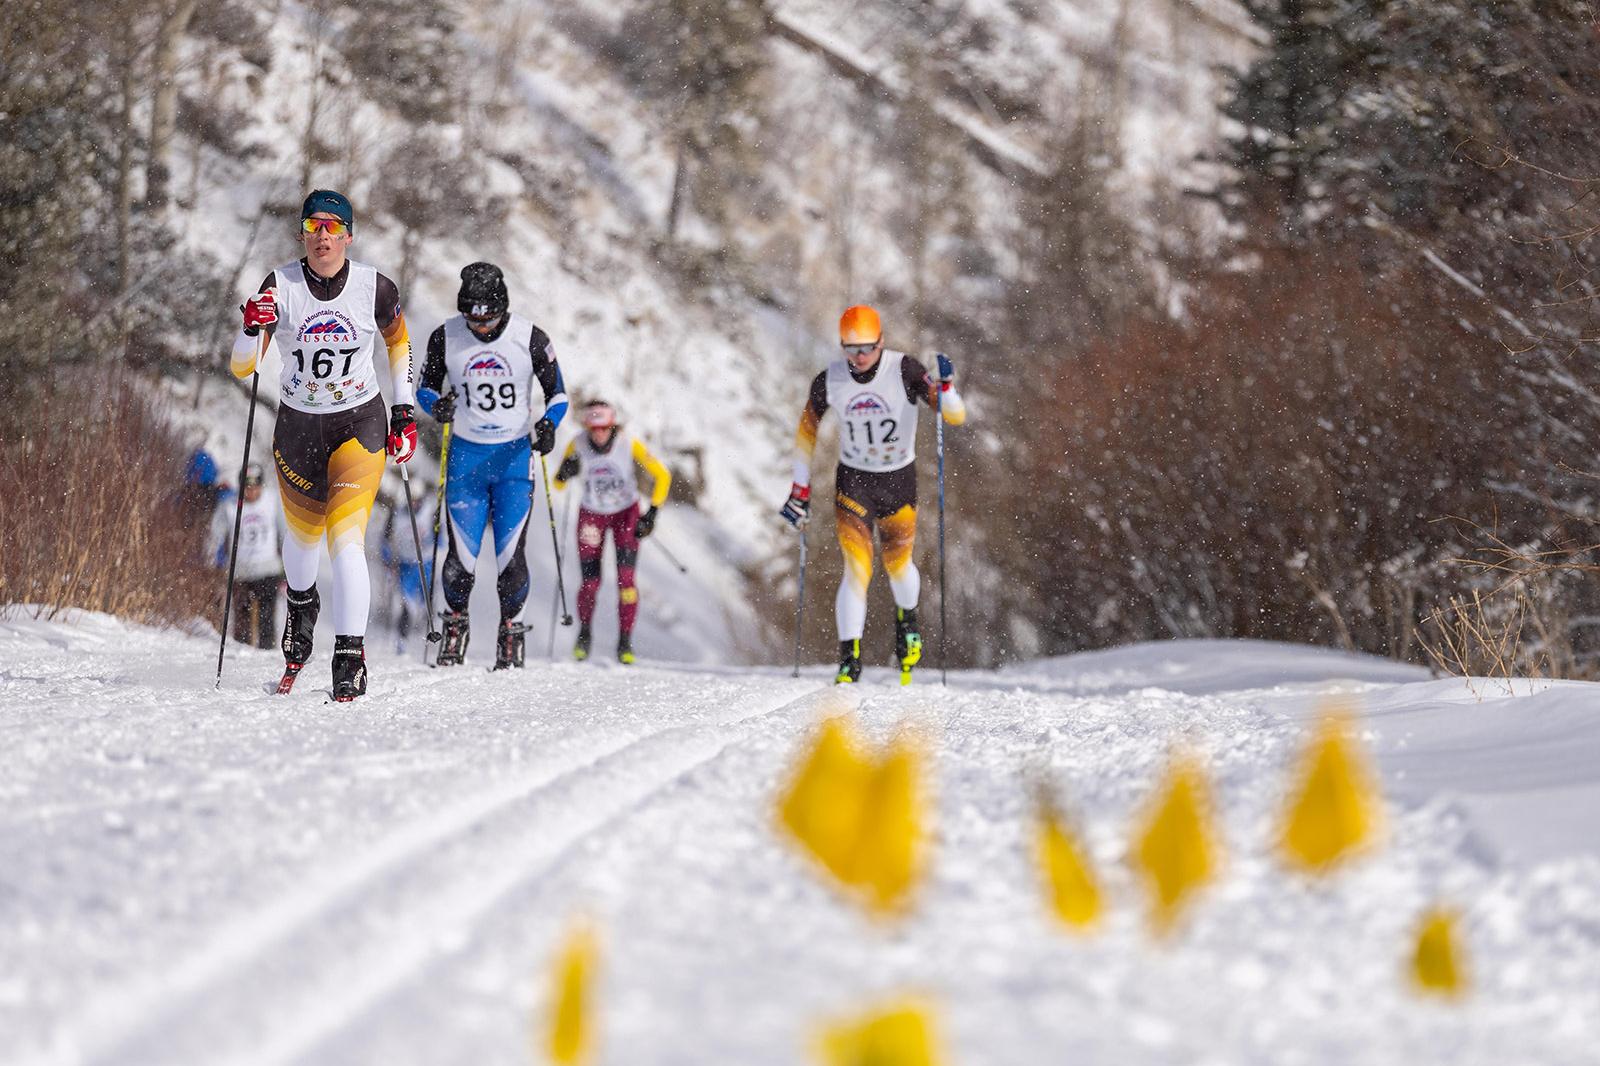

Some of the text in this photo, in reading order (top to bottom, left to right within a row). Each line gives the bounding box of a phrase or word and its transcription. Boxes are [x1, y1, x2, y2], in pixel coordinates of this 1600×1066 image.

[296, 309, 358, 341] Rocky Mountain Conference
[472, 304, 488, 315] AF
[303, 334, 350, 343] USCSA
[292, 346, 361, 379] 167
[461, 382, 516, 412] 139
[848, 419, 899, 444] 112
[275, 449, 314, 491] WYOMING
[284, 611, 293, 653] ADSHUS
